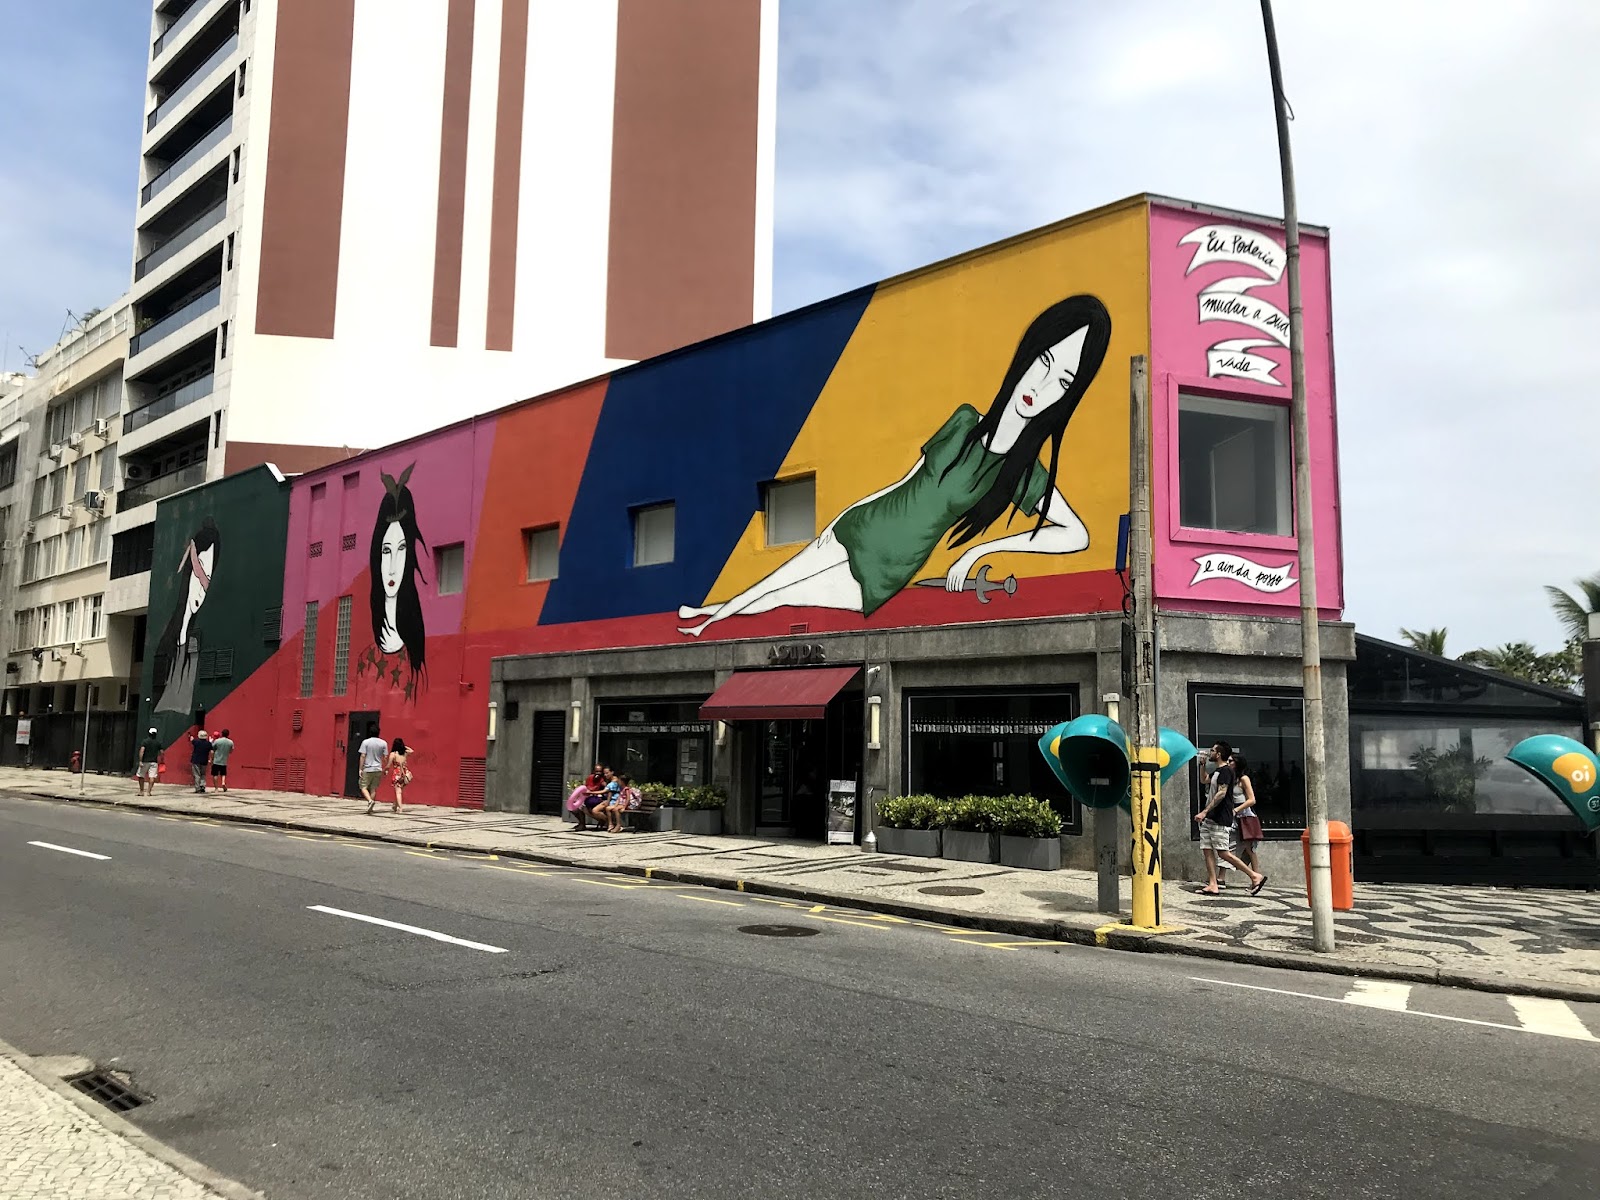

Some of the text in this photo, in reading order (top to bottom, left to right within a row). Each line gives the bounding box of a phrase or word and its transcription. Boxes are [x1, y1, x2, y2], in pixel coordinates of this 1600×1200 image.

[1232, 234, 1279, 270] Poderia
[1202, 297, 1289, 337] mudar a sua
[1216, 357, 1260, 373] vida
[1217, 561, 1251, 580] ainda
[1255, 571, 1283, 587] posso
[1138, 763, 1160, 926] TAXI
